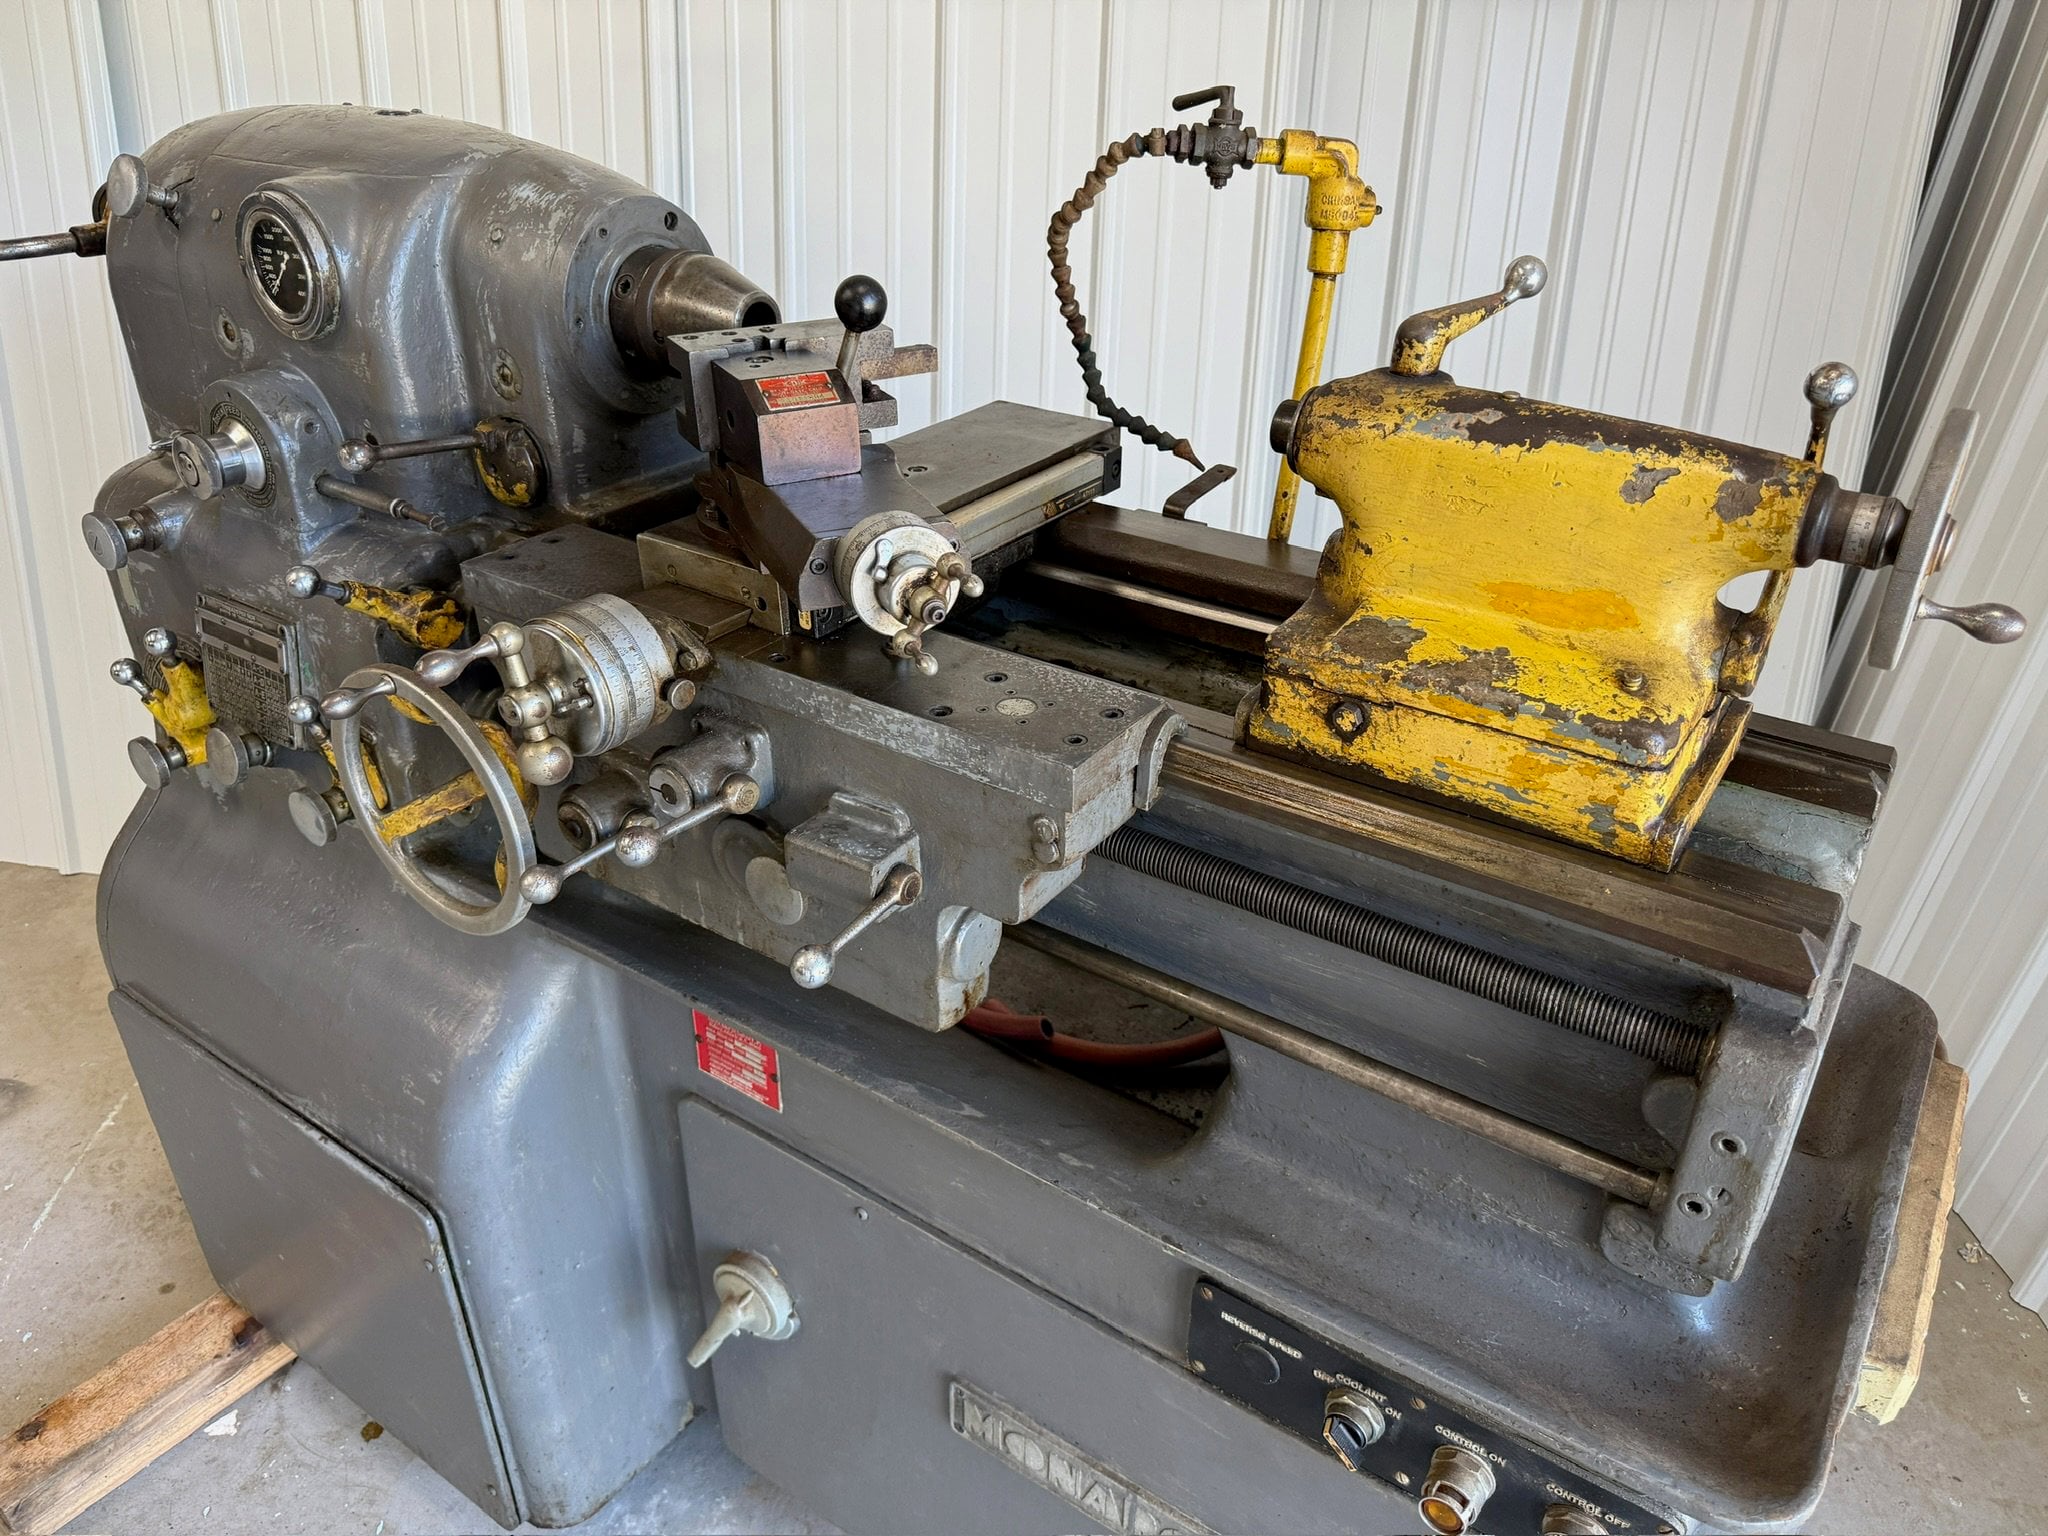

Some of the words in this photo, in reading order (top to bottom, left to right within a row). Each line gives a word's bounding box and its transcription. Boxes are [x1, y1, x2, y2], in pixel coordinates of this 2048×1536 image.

[1220, 1311, 1267, 1342] REVERSE
[1335, 1373, 1388, 1403] COOLANT
[1384, 1406, 1403, 1421] ON
[1434, 1423, 1488, 1457] CONTROL
[1488, 1452, 1507, 1468] ON
[1546, 1483, 1602, 1517] CONTROL
[1604, 1513, 1632, 1530] OFF
